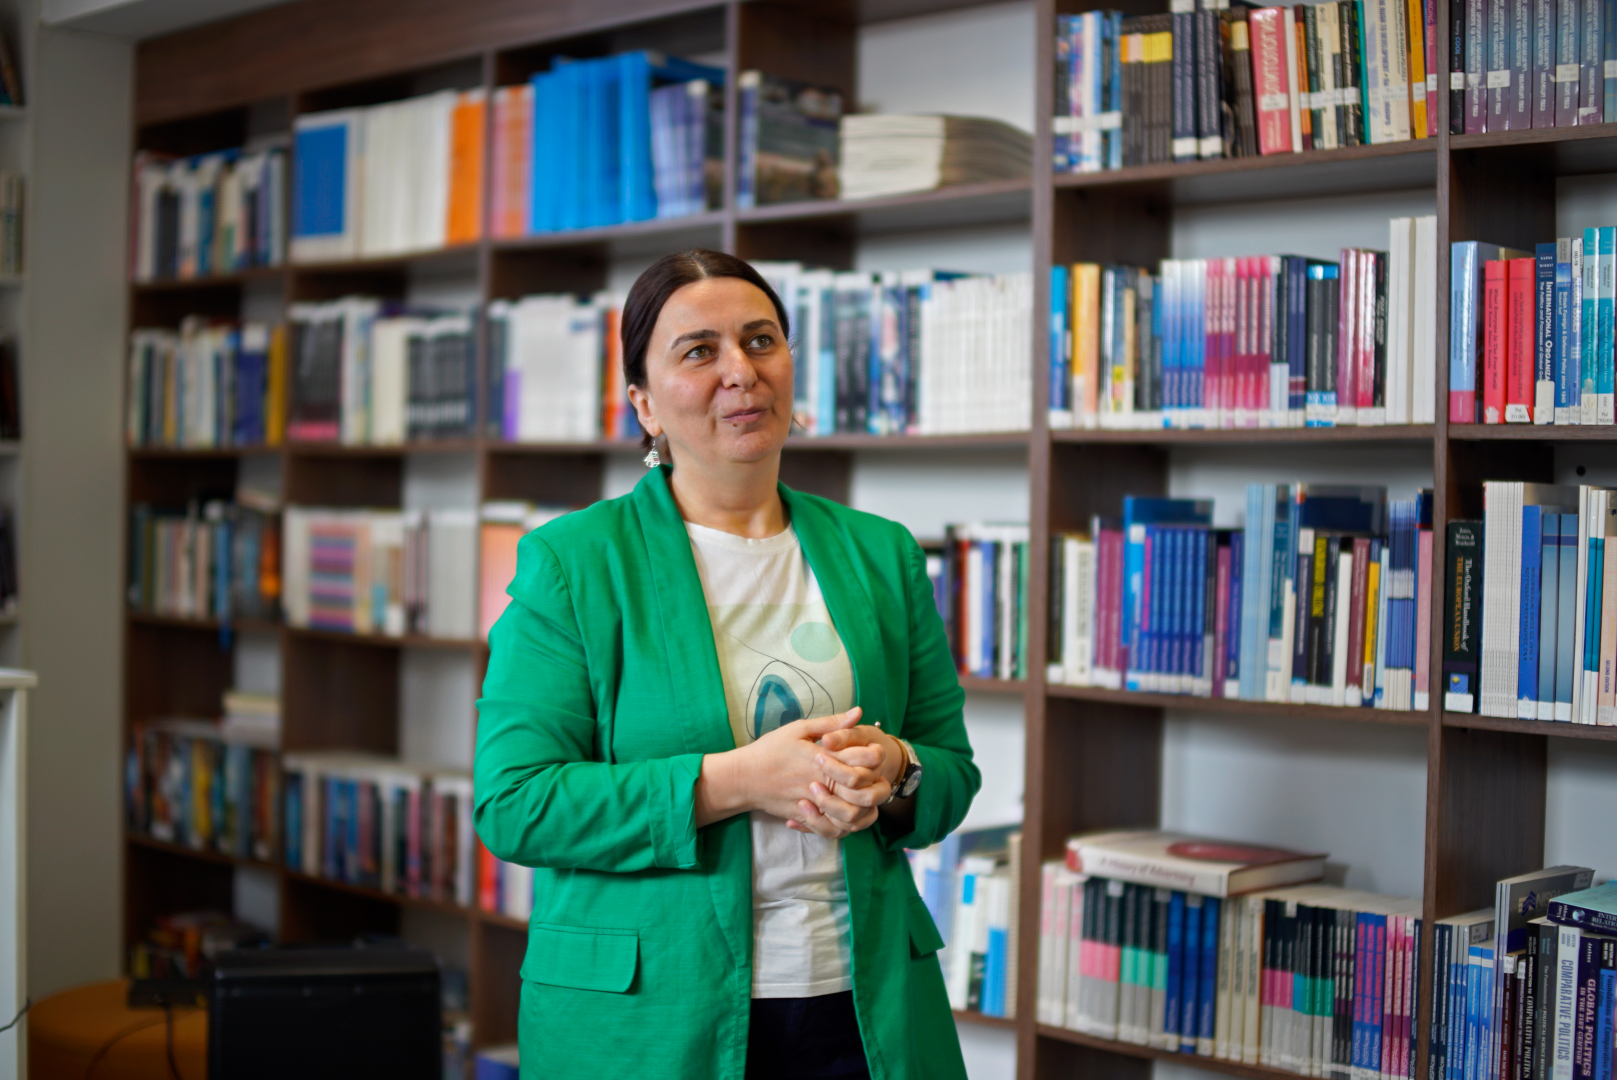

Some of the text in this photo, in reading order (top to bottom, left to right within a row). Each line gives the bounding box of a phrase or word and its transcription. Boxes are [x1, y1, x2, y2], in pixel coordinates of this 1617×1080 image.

[1260, 10, 1280, 95] ОЛИТОЛОГИЯ
[1545, 281, 1553, 338] INTERNATIONAL
[1455, 576, 1463, 622] EUROPEAN
[1464, 575, 1472, 601] Oxford
[1462, 602, 1471, 640] Handbook
[1530, 631, 1534, 639] TO
[1558, 960, 1573, 1060] COMPARATIVE POLITICS
[1580, 987, 1586, 995] IN
[1606, 975, 1614, 1016] Foundations
[1525, 996, 1534, 1045] COMPARATIVE
[1583, 979, 1596, 1076] GLOBAL POLITICS
[1524, 1046, 1532, 1079] POLITICS
[1603, 1027, 1611, 1068] Comparative
